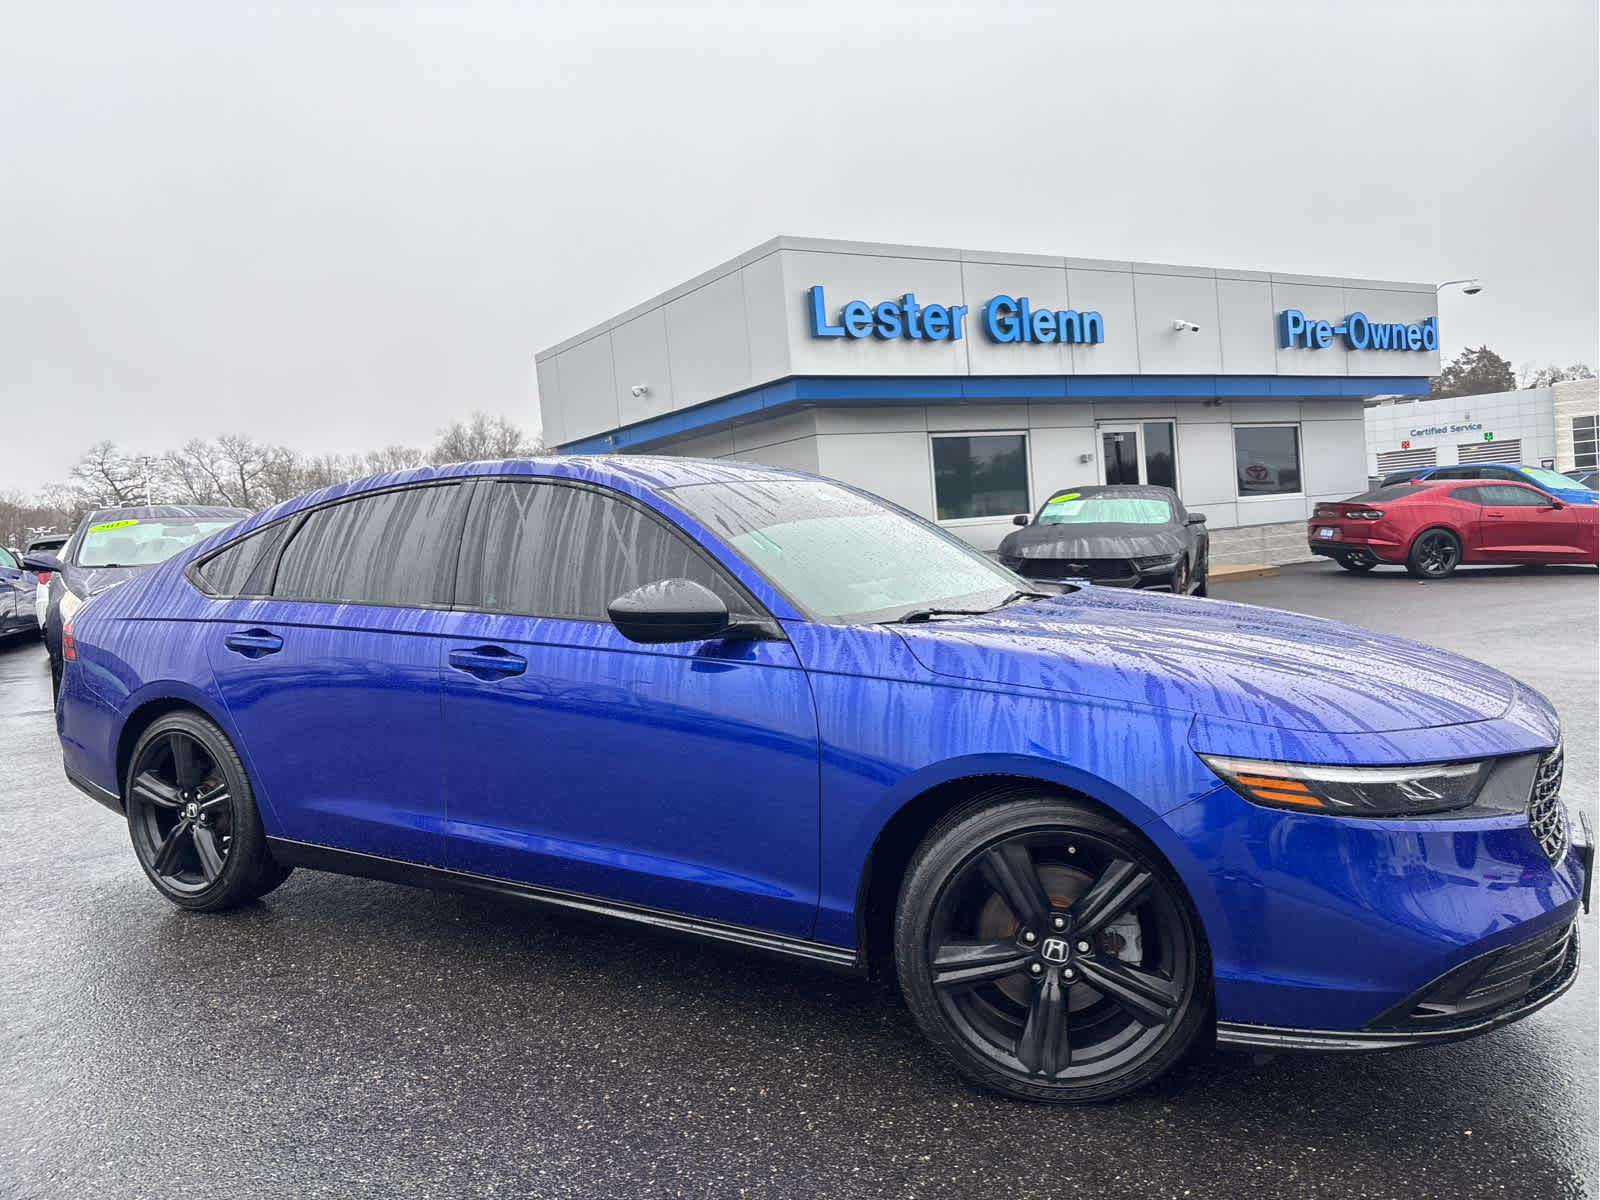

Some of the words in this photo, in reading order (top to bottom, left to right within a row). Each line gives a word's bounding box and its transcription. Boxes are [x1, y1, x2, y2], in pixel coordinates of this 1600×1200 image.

[808, 285, 968, 341] Lester
[984, 294, 1104, 344] Glenn
[1280, 309, 1438, 351] Pre-Owned
[1410, 425, 1448, 437] Certified
[1450, 422, 1483, 433] Service
